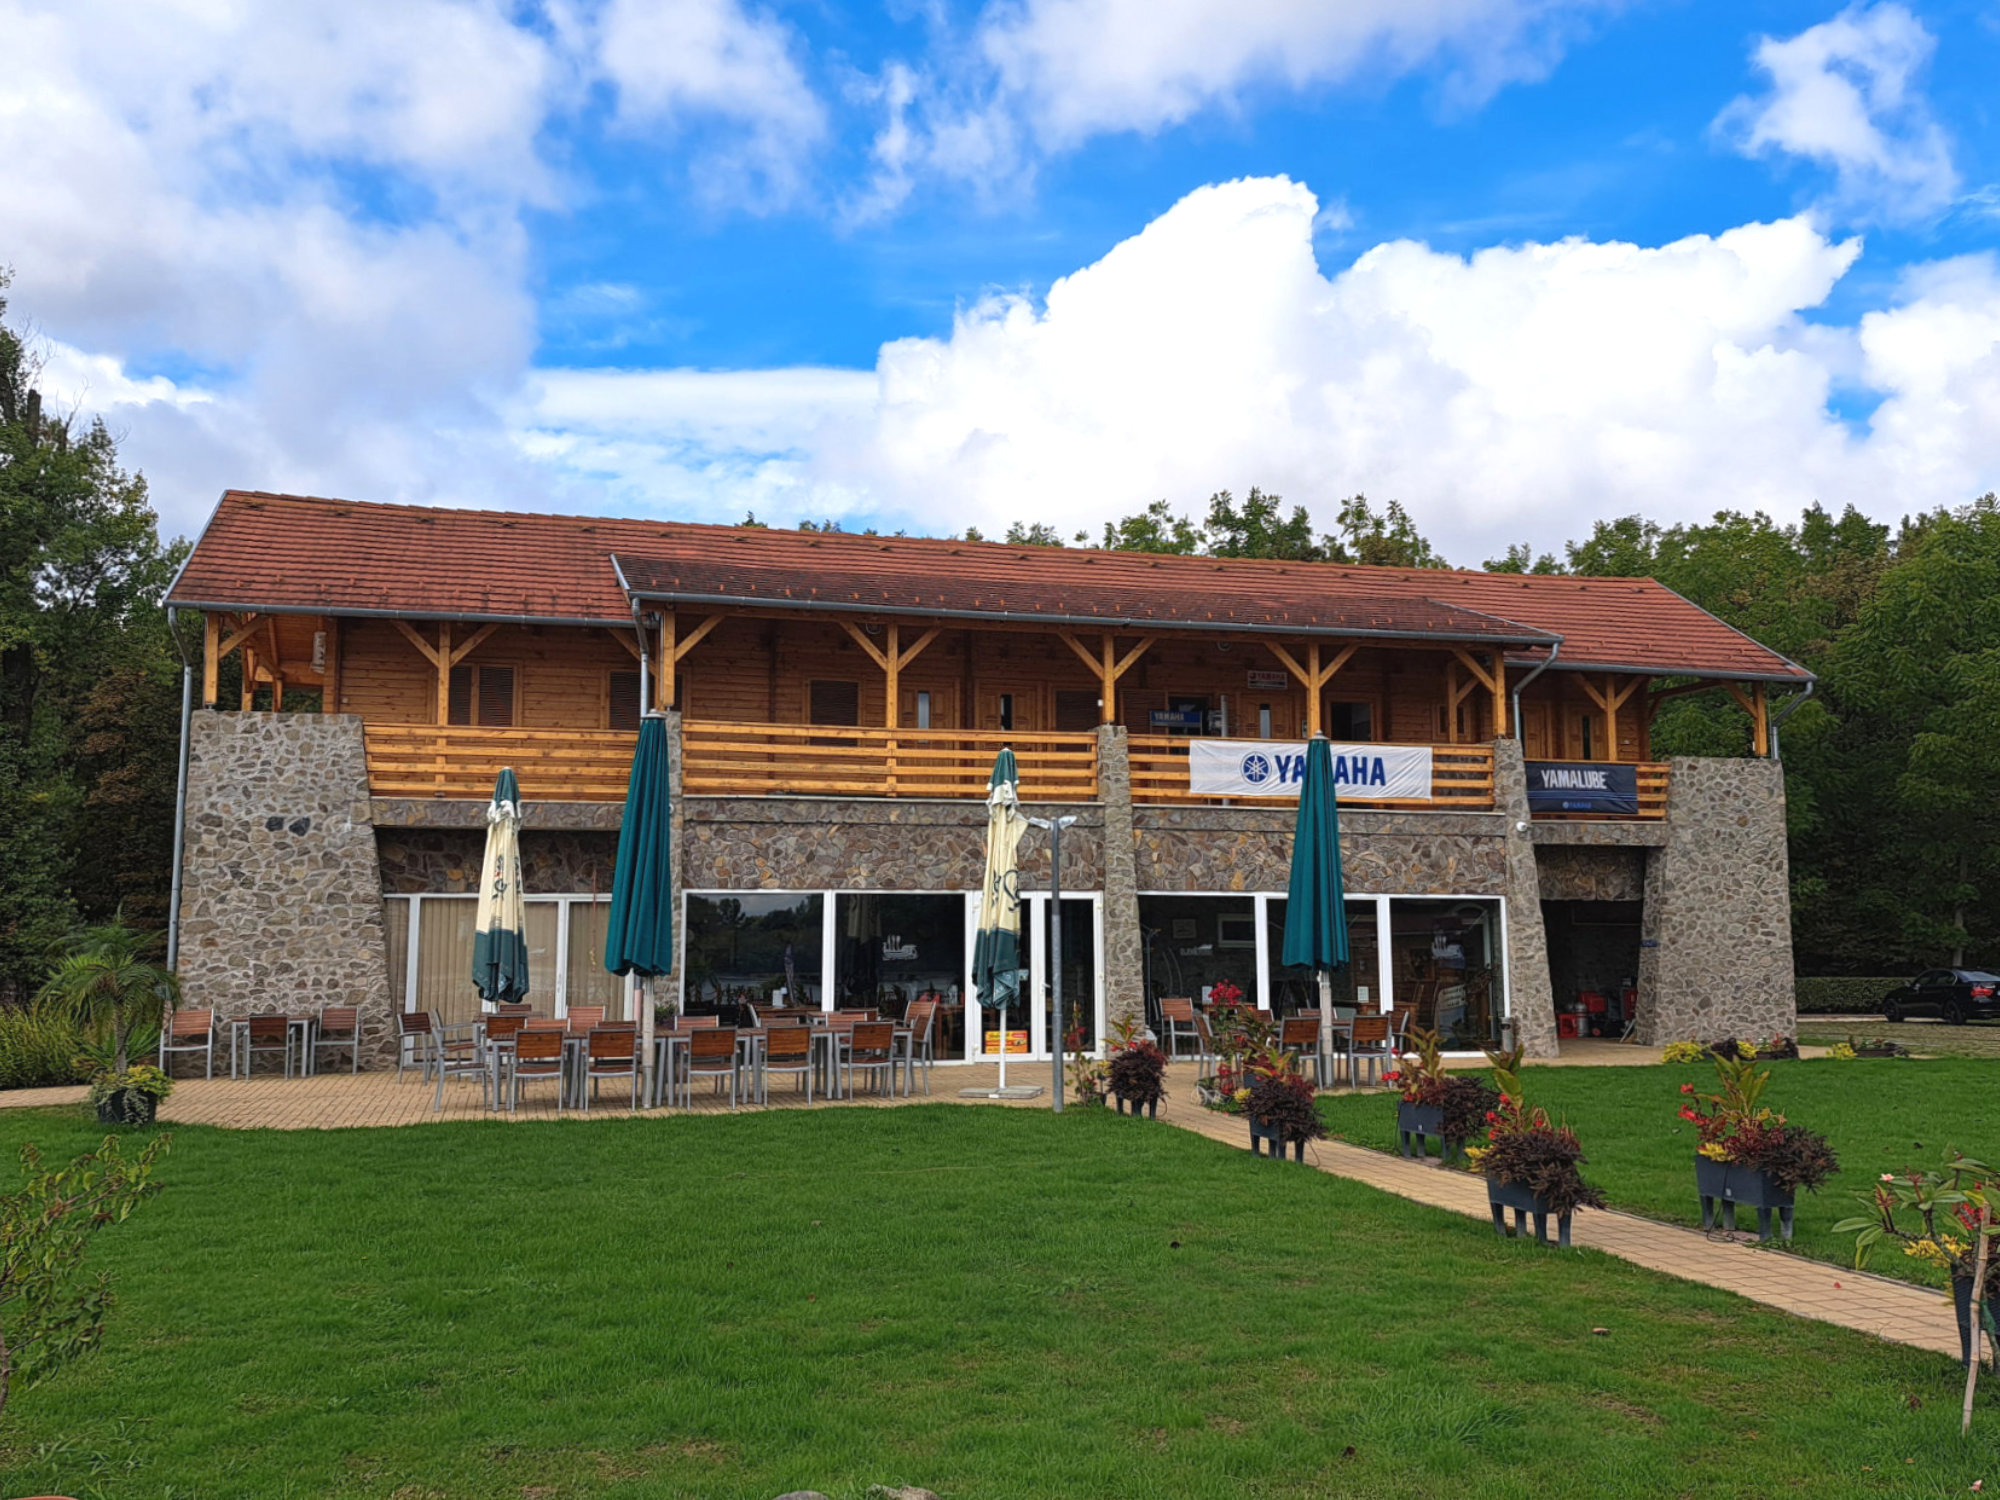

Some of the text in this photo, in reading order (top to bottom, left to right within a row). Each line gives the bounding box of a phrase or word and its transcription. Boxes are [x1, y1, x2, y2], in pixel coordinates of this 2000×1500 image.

[1154, 711, 1185, 721] YAMAHA
[1275, 755, 1386, 786] YAAHA
[1541, 769, 1608, 789] YAMALUBE
